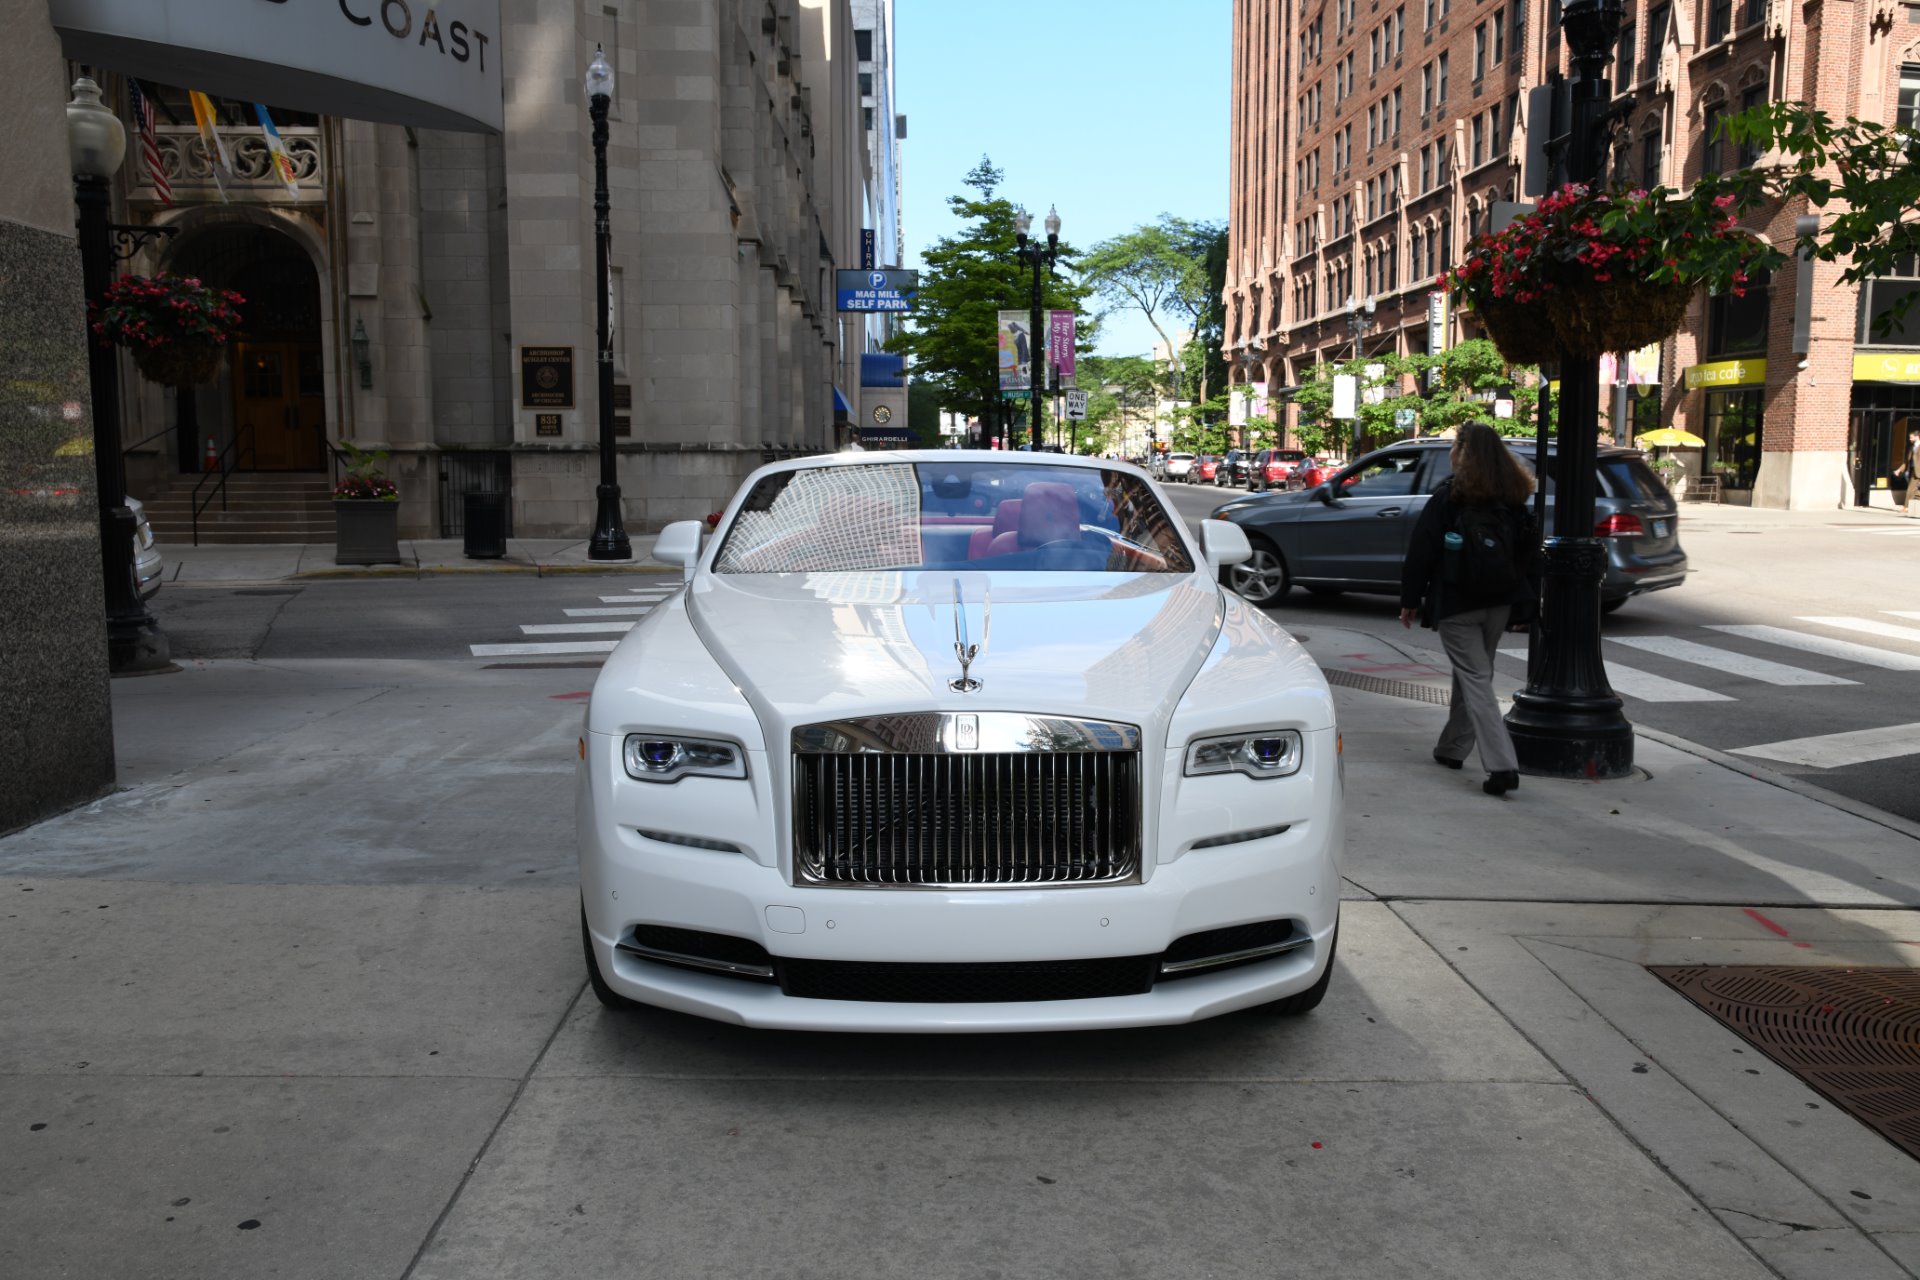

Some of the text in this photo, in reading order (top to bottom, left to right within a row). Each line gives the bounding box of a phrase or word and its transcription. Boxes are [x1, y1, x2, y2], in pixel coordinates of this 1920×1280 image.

[878, 290, 901, 298] MILE
[847, 300, 908, 309] SELF PARK
[1719, 360, 1746, 380] café
[1069, 393, 1085, 401] ONE
[1069, 401, 1085, 409] WAY
[540, 415, 557, 425] 835
